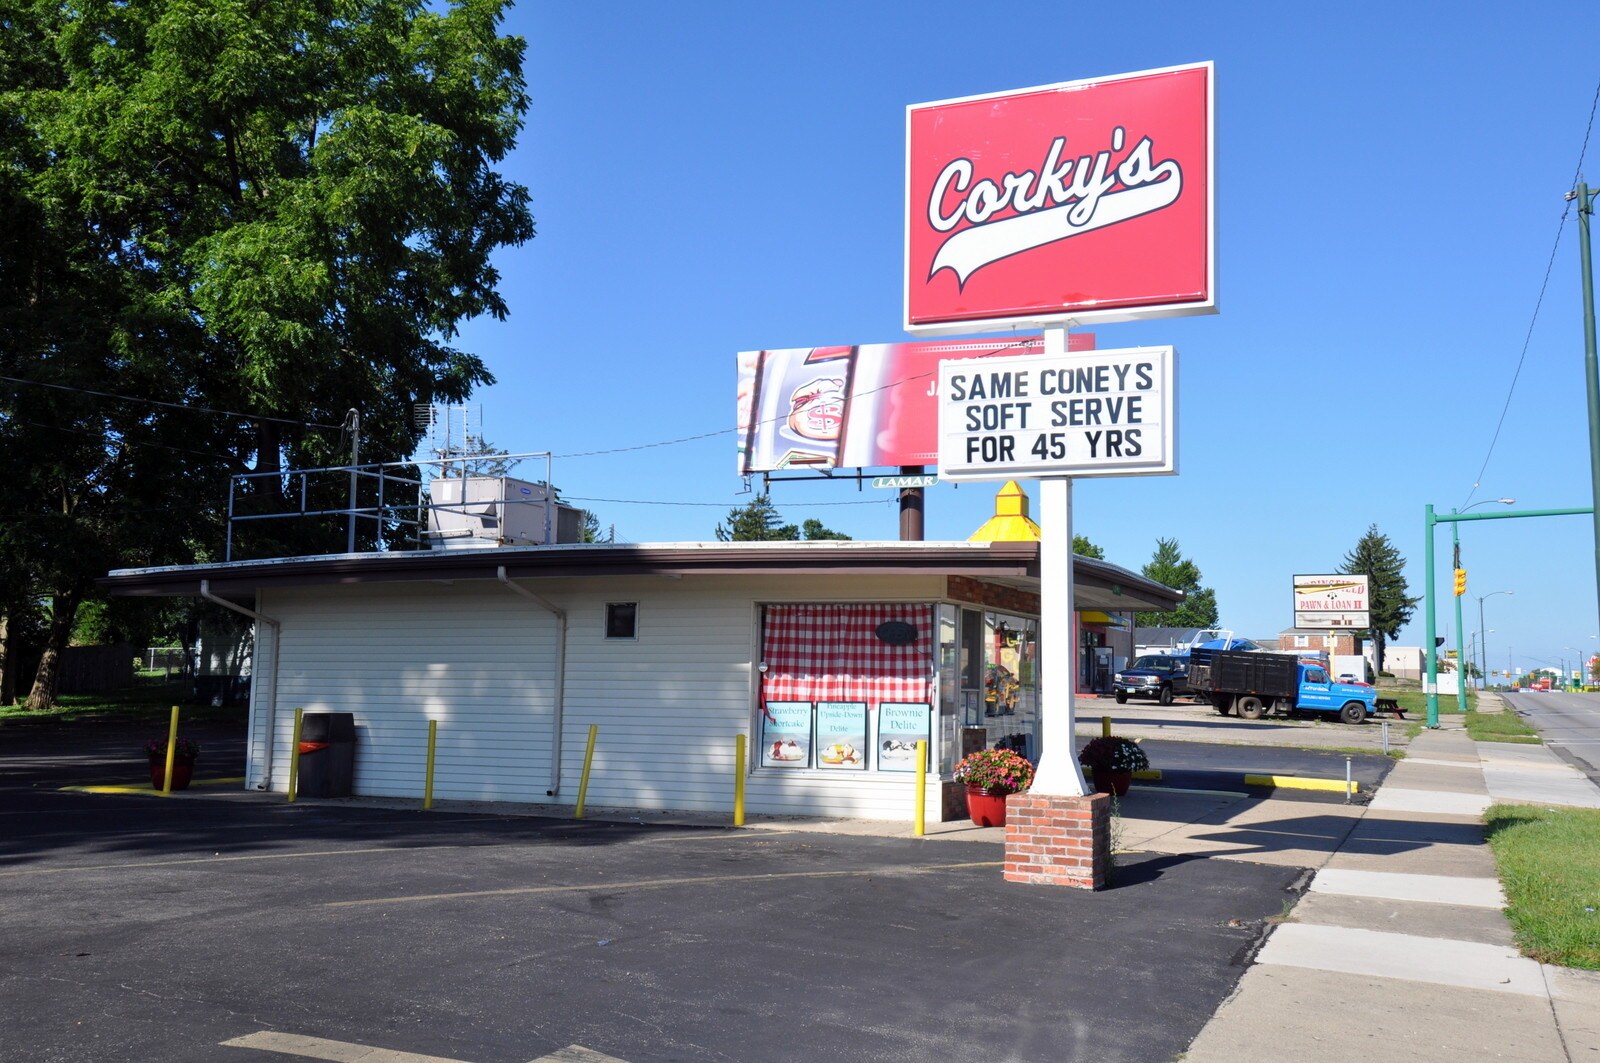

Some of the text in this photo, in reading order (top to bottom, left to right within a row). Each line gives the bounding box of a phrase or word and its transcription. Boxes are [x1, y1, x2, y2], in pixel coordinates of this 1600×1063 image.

[927, 126, 1182, 233] Corky's
[951, 371, 1029, 402] SAME
[1040, 362, 1153, 396] CONEYS
[966, 396, 1142, 432] SOFT SERVE
[966, 429, 1142, 463] FOR 45 YRS
[878, 476, 934, 487] LAMAR
[1300, 600, 1362, 610] PAWN & LOAN II
[768, 706, 808, 716] Strawberry
[826, 702, 857, 711] Pineapple
[820, 711, 863, 719] Upside-Down
[885, 707, 924, 717] Brownie
[890, 720, 917, 730] Delite
